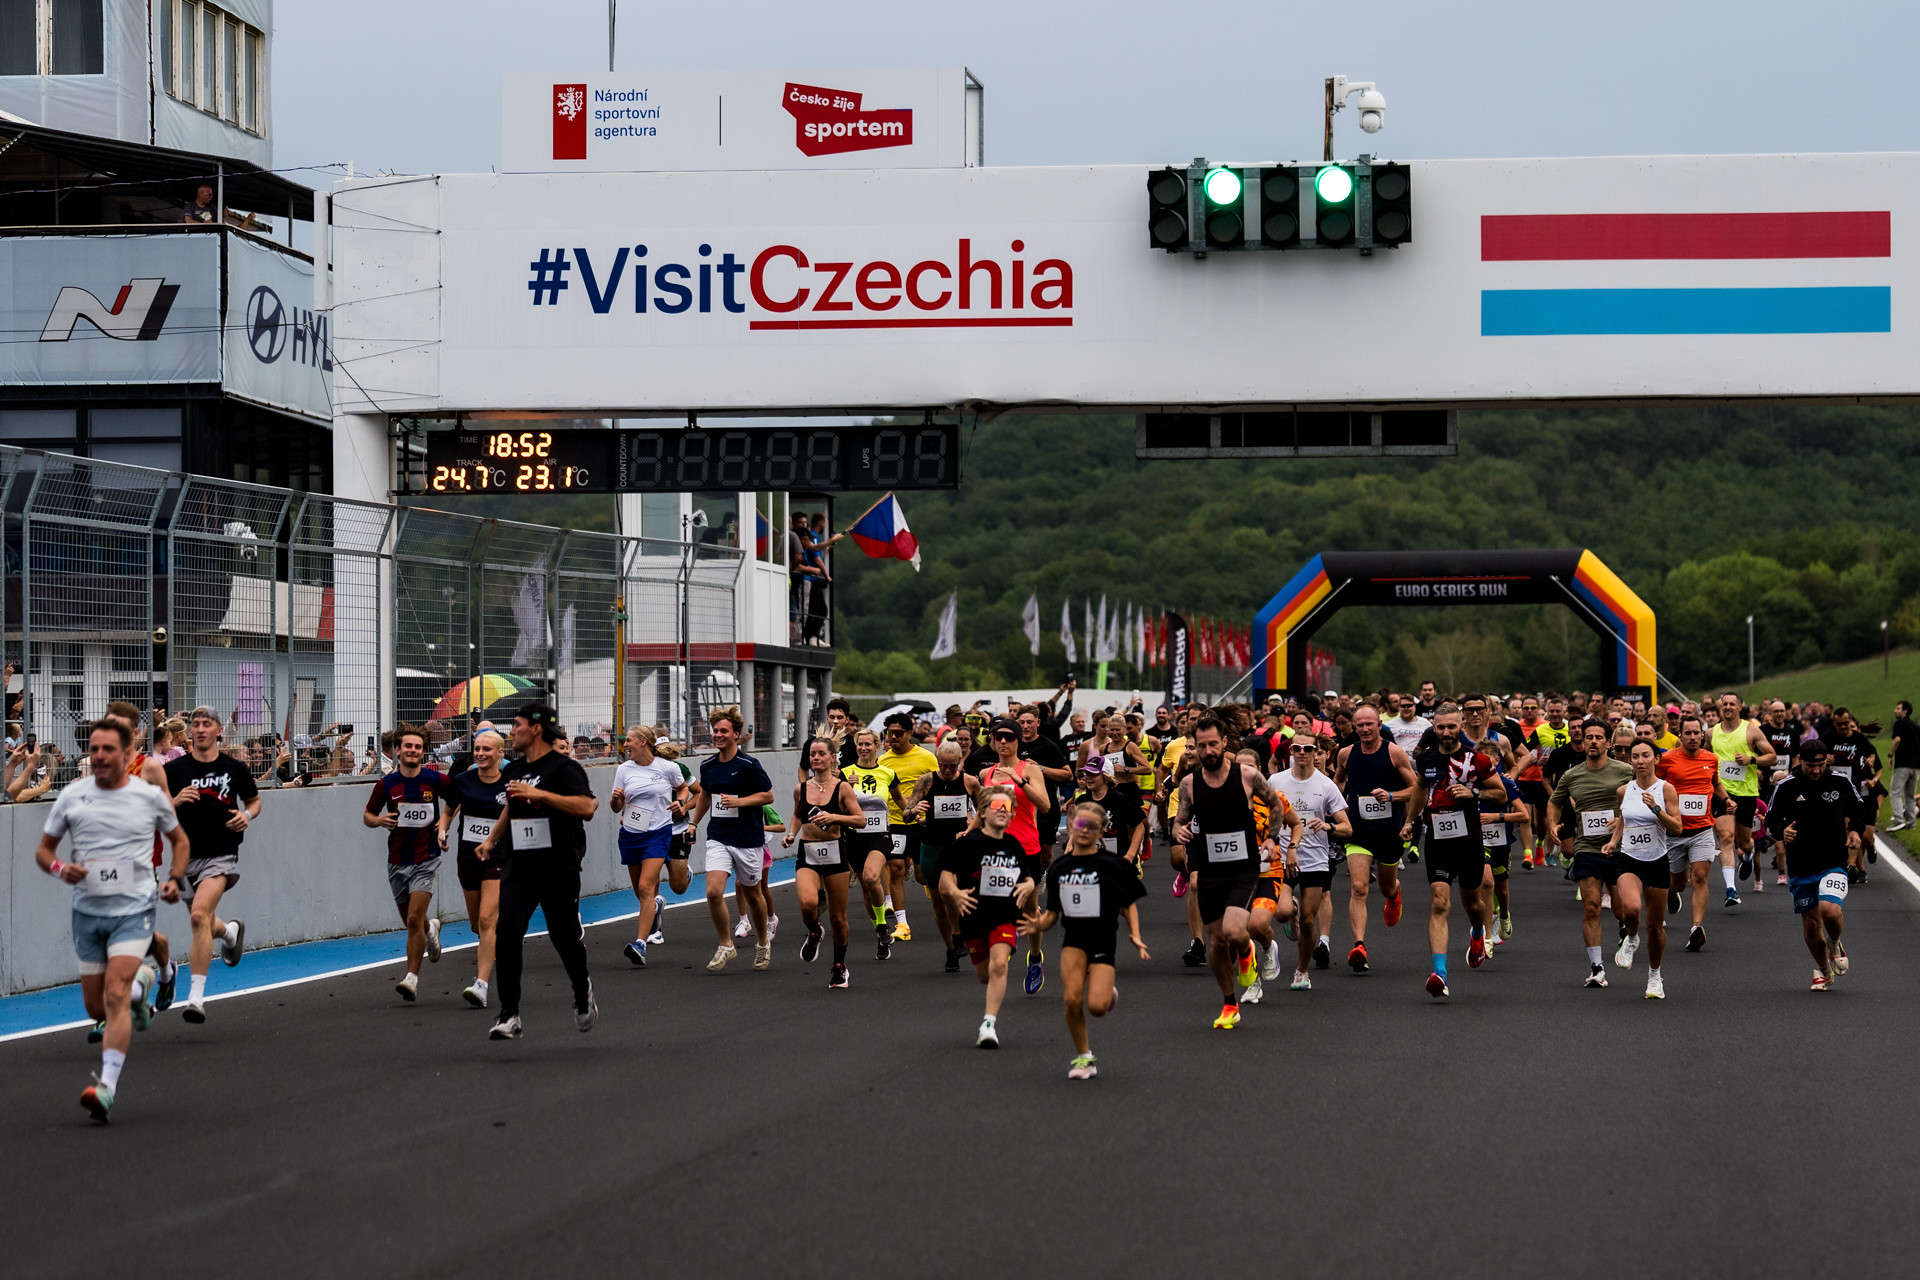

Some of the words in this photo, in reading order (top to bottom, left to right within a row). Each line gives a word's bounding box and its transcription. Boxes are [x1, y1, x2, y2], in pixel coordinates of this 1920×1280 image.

[594, 89, 648, 102] Národní
[789, 88, 830, 106] Česko
[832, 96, 855, 112] žije
[594, 106, 660, 121] sportovní
[594, 125, 657, 140] agentura
[804, 119, 904, 143] sportem
[528, 238, 1073, 314] #VisitCzechia
[459, 436, 478, 444] TIME
[489, 432, 552, 457] 18:52
[456, 459, 483, 467] TRACK
[543, 458, 557, 466] AIR
[619, 433, 627, 487] COUNTDOWN
[862, 447, 870, 469] LAPS
[1395, 584, 1430, 598] EURO
[1432, 583, 1476, 597] SERIES
[1479, 583, 1508, 596] RUN
[1724, 766, 1741, 775] 472
[941, 802, 962, 812] 842
[1365, 802, 1386, 812] 665
[1684, 800, 1703, 810] 908
[404, 810, 427, 820] 490
[631, 811, 641, 821] 52
[865, 816, 881, 826] 69
[1438, 820, 1458, 831] 331
[1587, 818, 1608, 828] 239
[469, 824, 491, 835] 428
[524, 827, 533, 837] 11
[1629, 833, 1652, 845] 346
[816, 848, 828, 857] 10
[1214, 841, 1238, 853] 575
[100, 868, 118, 881] 54
[988, 875, 1015, 888] 388
[1826, 879, 1846, 892] 963
[1072, 893, 1081, 905] 8
